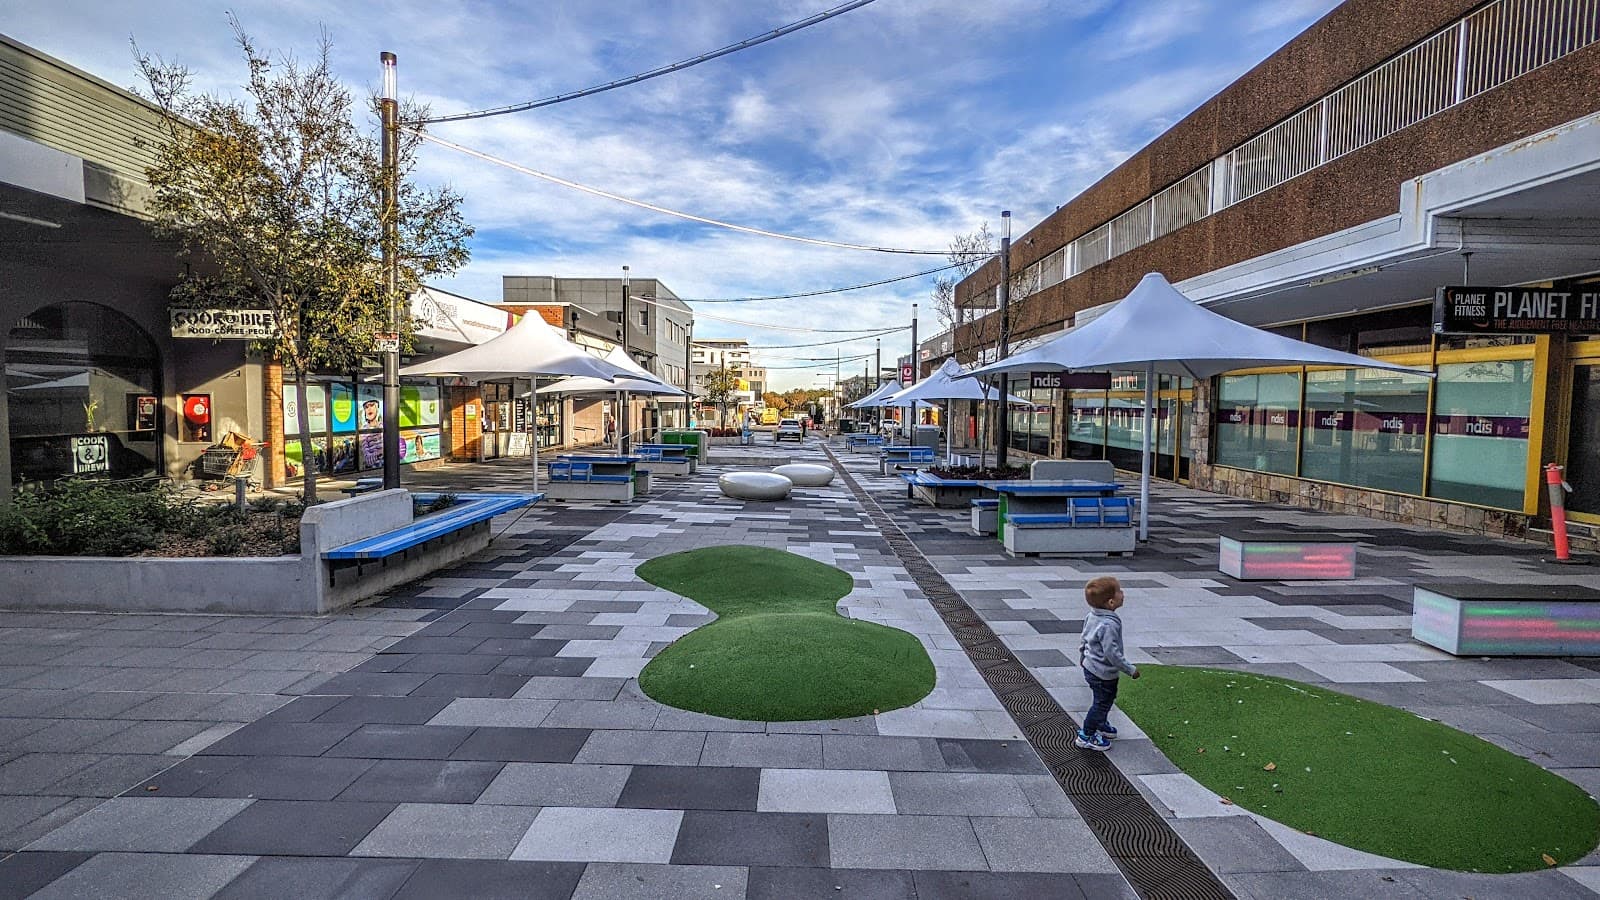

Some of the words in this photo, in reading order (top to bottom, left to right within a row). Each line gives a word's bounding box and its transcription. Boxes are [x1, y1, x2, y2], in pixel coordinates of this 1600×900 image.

[1455, 294, 1486, 305] PLANET
[1494, 291, 1571, 318] PLANET
[1580, 292, 1600, 319] FI
[1454, 305, 1486, 317] FITNESS
[174, 312, 224, 326] COOK
[1033, 374, 1060, 387] ndis
[1270, 413, 1284, 424] ndis
[1321, 415, 1337, 426] ndis
[1383, 417, 1403, 429] ndis
[1465, 420, 1492, 434] ndis
[78, 436, 104, 445] COOK
[85, 448, 94, 460] &
[78, 463, 104, 472] BREW
